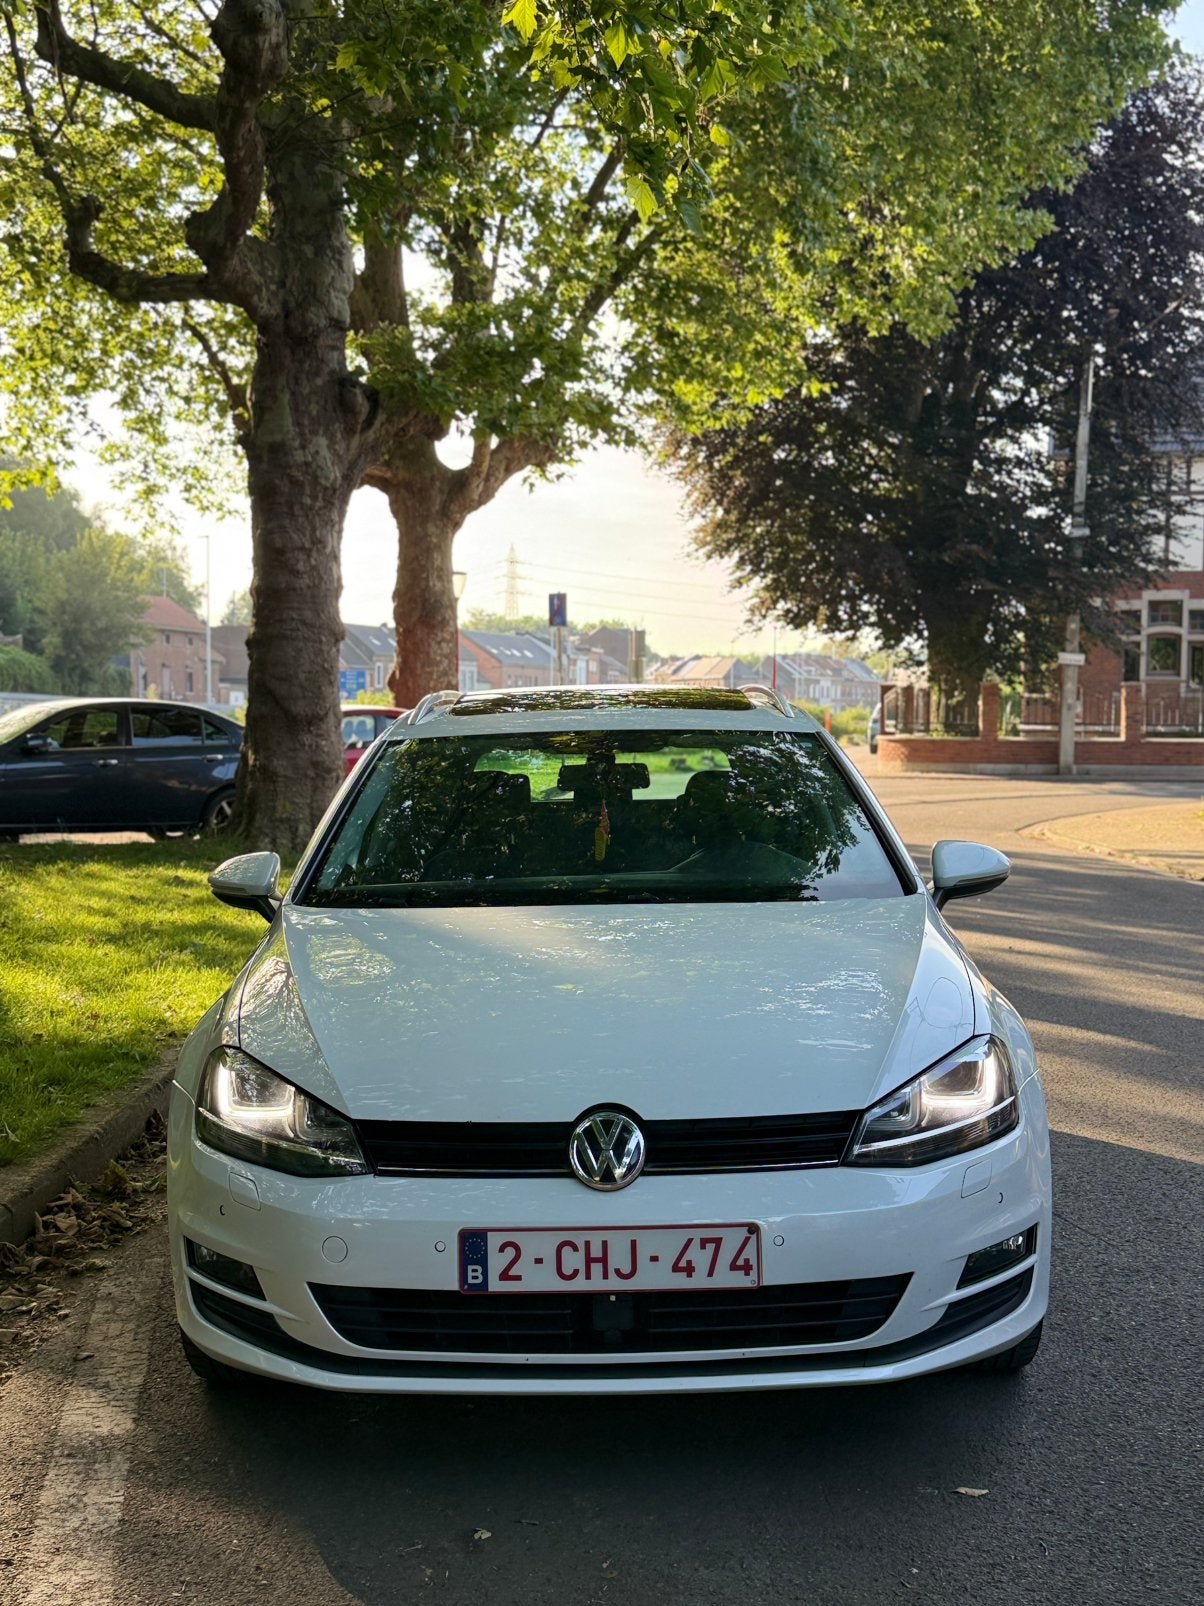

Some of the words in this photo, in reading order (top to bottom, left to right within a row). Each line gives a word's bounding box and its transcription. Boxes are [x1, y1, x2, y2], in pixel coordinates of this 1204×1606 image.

[573, 1115, 642, 1186] VW
[467, 1264, 484, 1284] B
[498, 1236, 754, 1281] 2-CHJ-474
